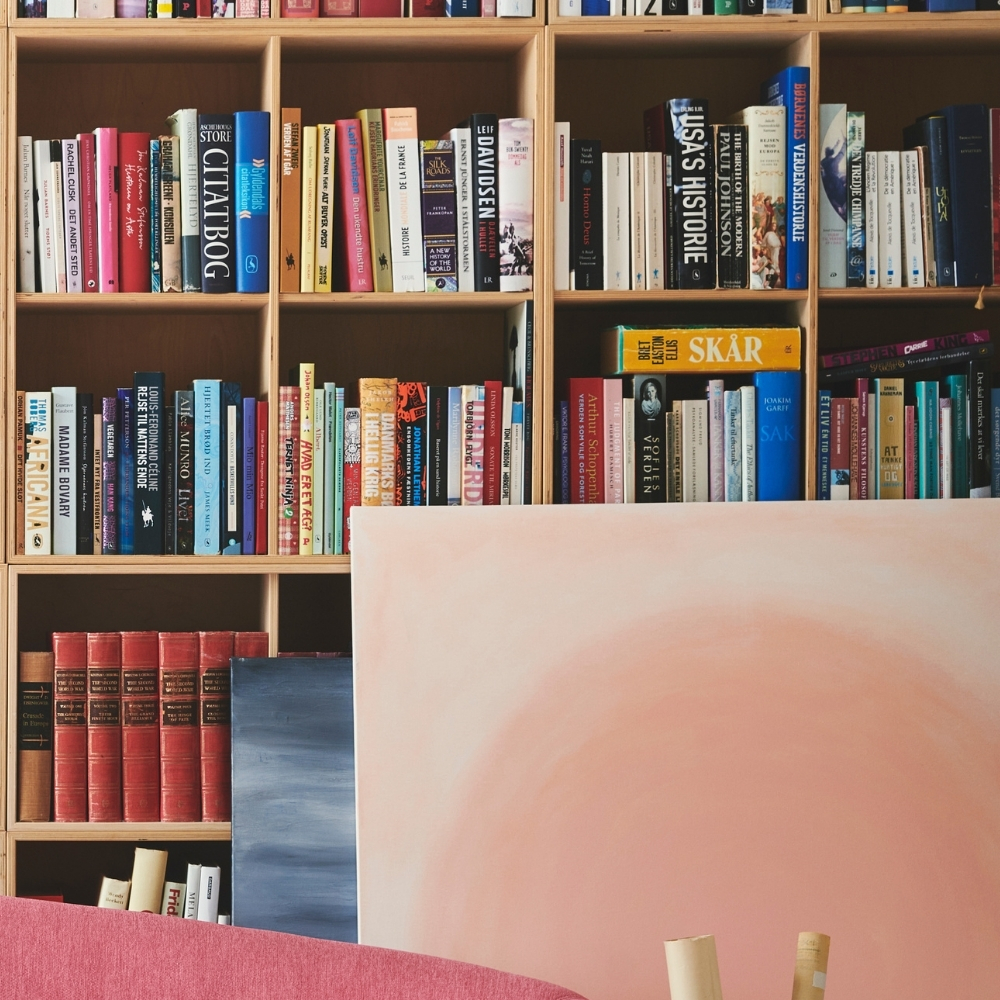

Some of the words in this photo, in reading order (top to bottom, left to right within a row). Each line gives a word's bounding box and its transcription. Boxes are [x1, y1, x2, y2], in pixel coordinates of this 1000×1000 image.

[794, 83, 806, 140] BØRNENES
[200, 130, 232, 142] STORE
[283, 123, 291, 148] VERDEN
[291, 123, 299, 146] STEFAN
[477, 125, 494, 134] LEIF
[681, 115, 705, 170] USA'S
[67, 143, 75, 178] RACHEL
[284, 149, 291, 157] AF
[284, 162, 293, 175] GÅR
[720, 132, 731, 172] PAUL
[851, 145, 862, 162] DEN
[68, 179, 76, 202] CUSK
[460, 168, 469, 202] JÜNGER
[478, 136, 495, 219] DAVIDSEN
[792, 143, 806, 242] VERDENSHISTORIE
[850, 163, 862, 196] TREDJE
[202, 148, 230, 279] CITATBOG
[682, 177, 708, 264] HISTORIE
[719, 176, 732, 257] JOHNSON
[851, 198, 862, 248] CHIMPANSE
[462, 210, 470, 273] STÅLSTORMEN
[638, 340, 650, 360] BRET
[652, 335, 664, 365] EASTON
[665, 339, 677, 361] ELLIS
[688, 334, 763, 365] SKÅR
[137, 386, 147, 412] REJSE
[203, 386, 211, 426] HJERTET
[137, 414, 147, 427] TIL
[148, 386, 158, 461] LOUIS-FERDINAND
[59, 425, 70, 473] MADAME
[137, 429, 147, 465] NATTENS
[365, 420, 379, 464] HELLIG
[381, 413, 395, 488] DANMARKS
[137, 467, 147, 489] ENDE
[148, 463, 160, 491] CÉLINE
[643, 436, 652, 493] VERDEN
[652, 437, 660, 491] SOFIES
[26, 434, 49, 531] AFRICANA
[59, 477, 70, 518] BOVARY
[365, 467, 379, 497] KRIG
